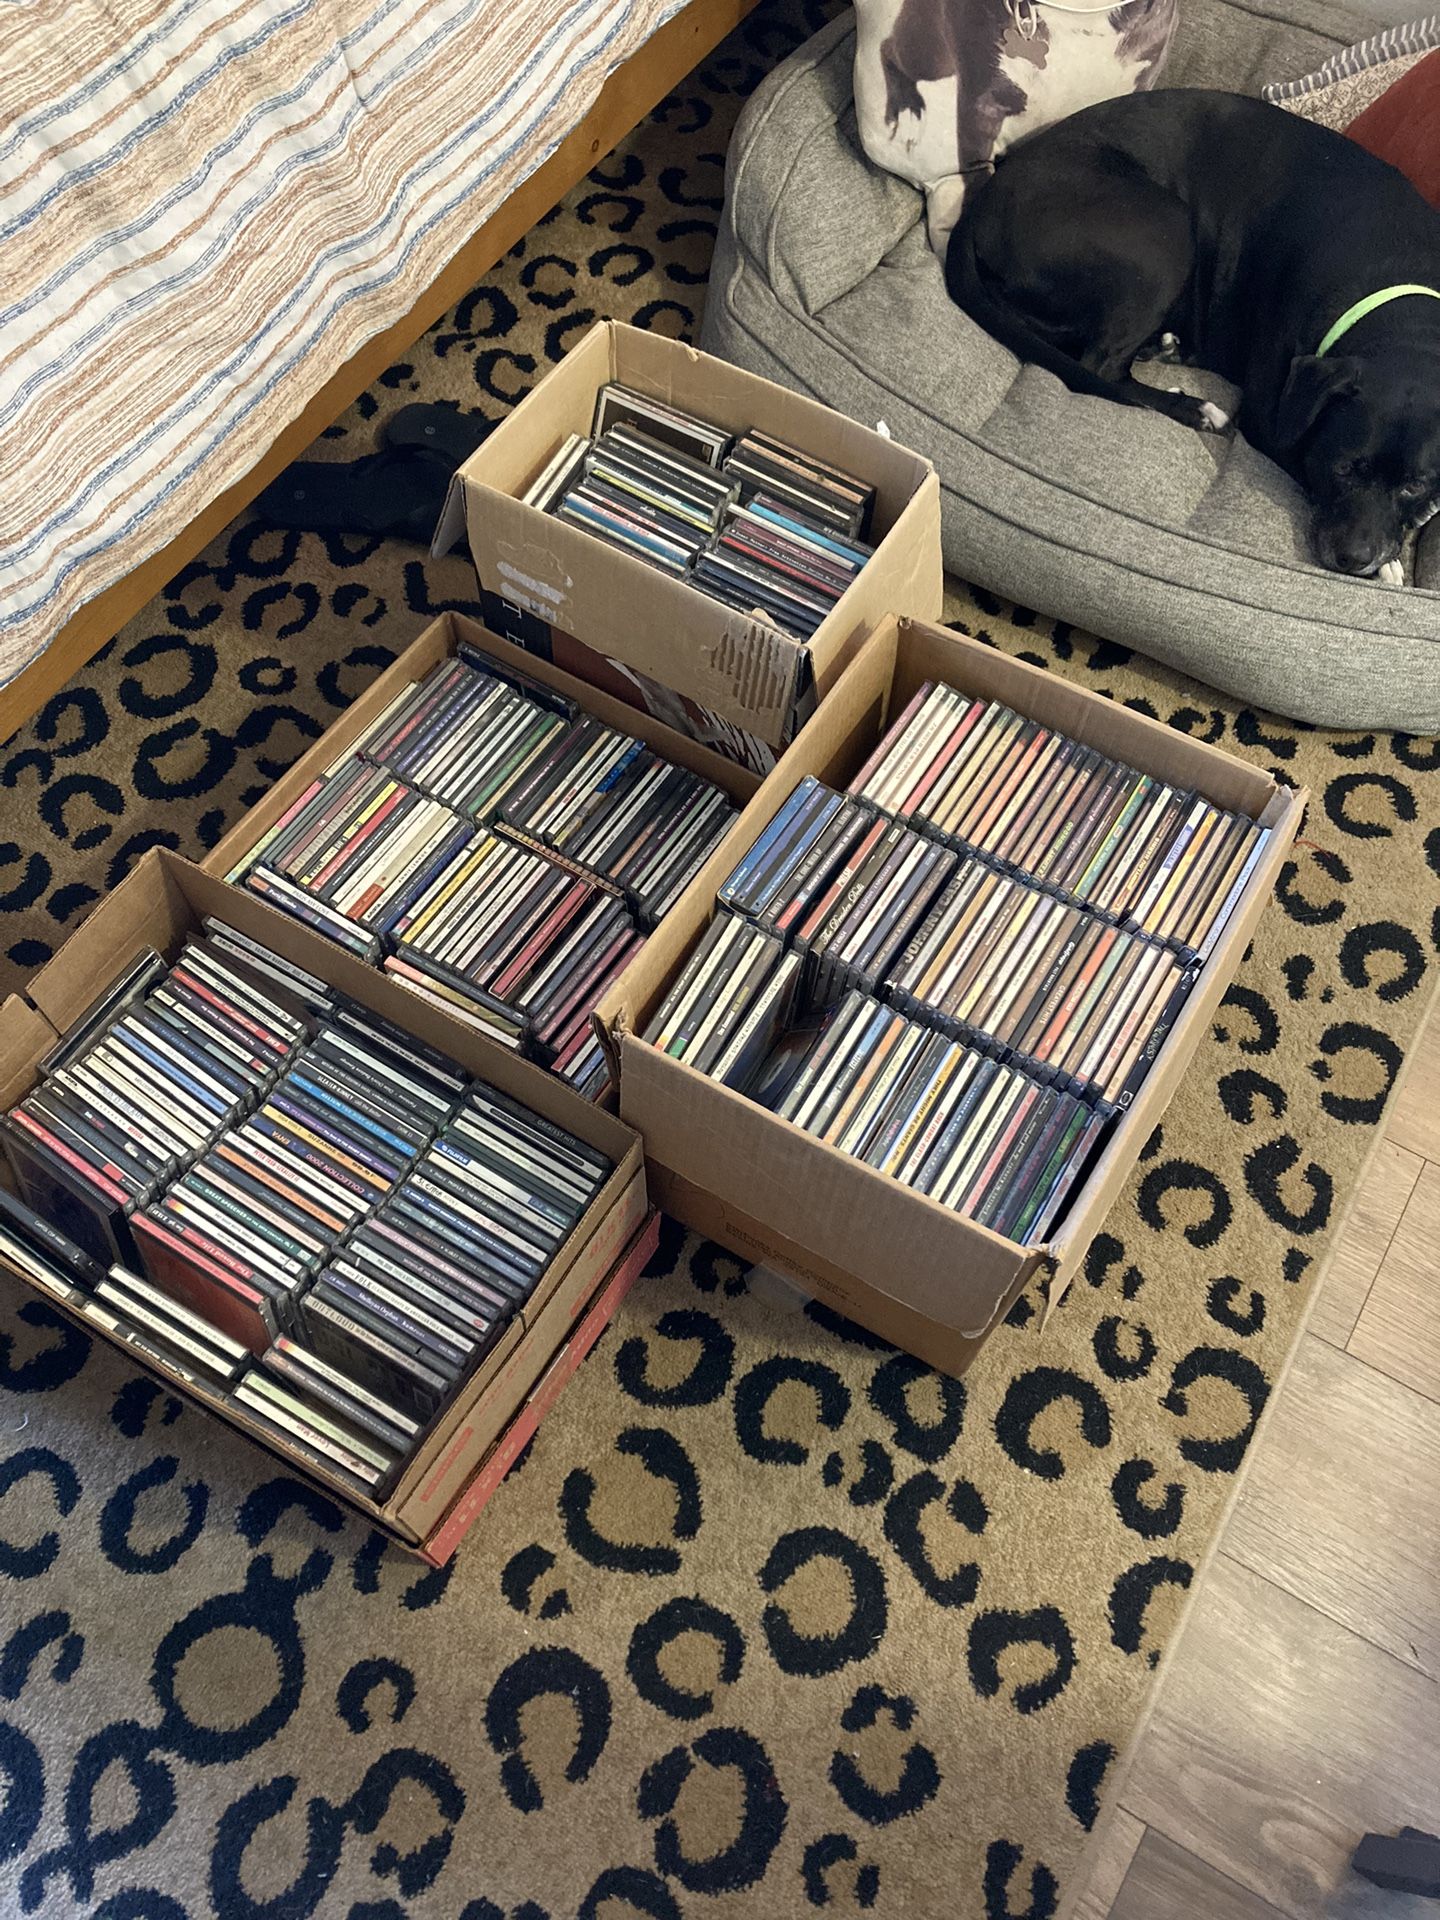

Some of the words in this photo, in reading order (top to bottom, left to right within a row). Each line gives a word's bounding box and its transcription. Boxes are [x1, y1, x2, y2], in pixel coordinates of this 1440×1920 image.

[818, 842, 844, 875] EVERYTHING
[846, 816, 863, 836] WRONG
[1142, 836, 1159, 859] HARRIS
[817, 926, 834, 944] The
[900, 905, 943, 965] JOHNNY
[1047, 984, 1066, 1011] GREATEST
[1039, 1011, 1050, 1024] HITS
[265, 1034, 280, 1047] EMI
[317, 1075, 353, 1100] SLEATER-KINNEY
[930, 1079, 941, 1094] THEY
[397, 1094, 416, 1108] Fishbone
[919, 1094, 932, 1113] MIGHT
[912, 1115, 920, 1124] BE
[270, 1130, 290, 1146] ENYA
[536, 1119, 564, 1137] GREATEST
[563, 1134, 576, 1144] HITS
[899, 1123, 915, 1146] GIANTS
[909, 1158, 917, 1167] THE
[934, 1110, 944, 1124] ROCK
[307, 1133, 336, 1153] SUZANNE
[304, 1152, 324, 1168] 2000
[446, 1148, 468, 1163] FUJIFILM
[322, 1163, 365, 1194] COLLECTION
[204, 1188, 221, 1201] GREAT
[220, 1199, 247, 1219] SPEECHES
[235, 1264, 250, 1276] The
[354, 1274, 372, 1288] FOLK
